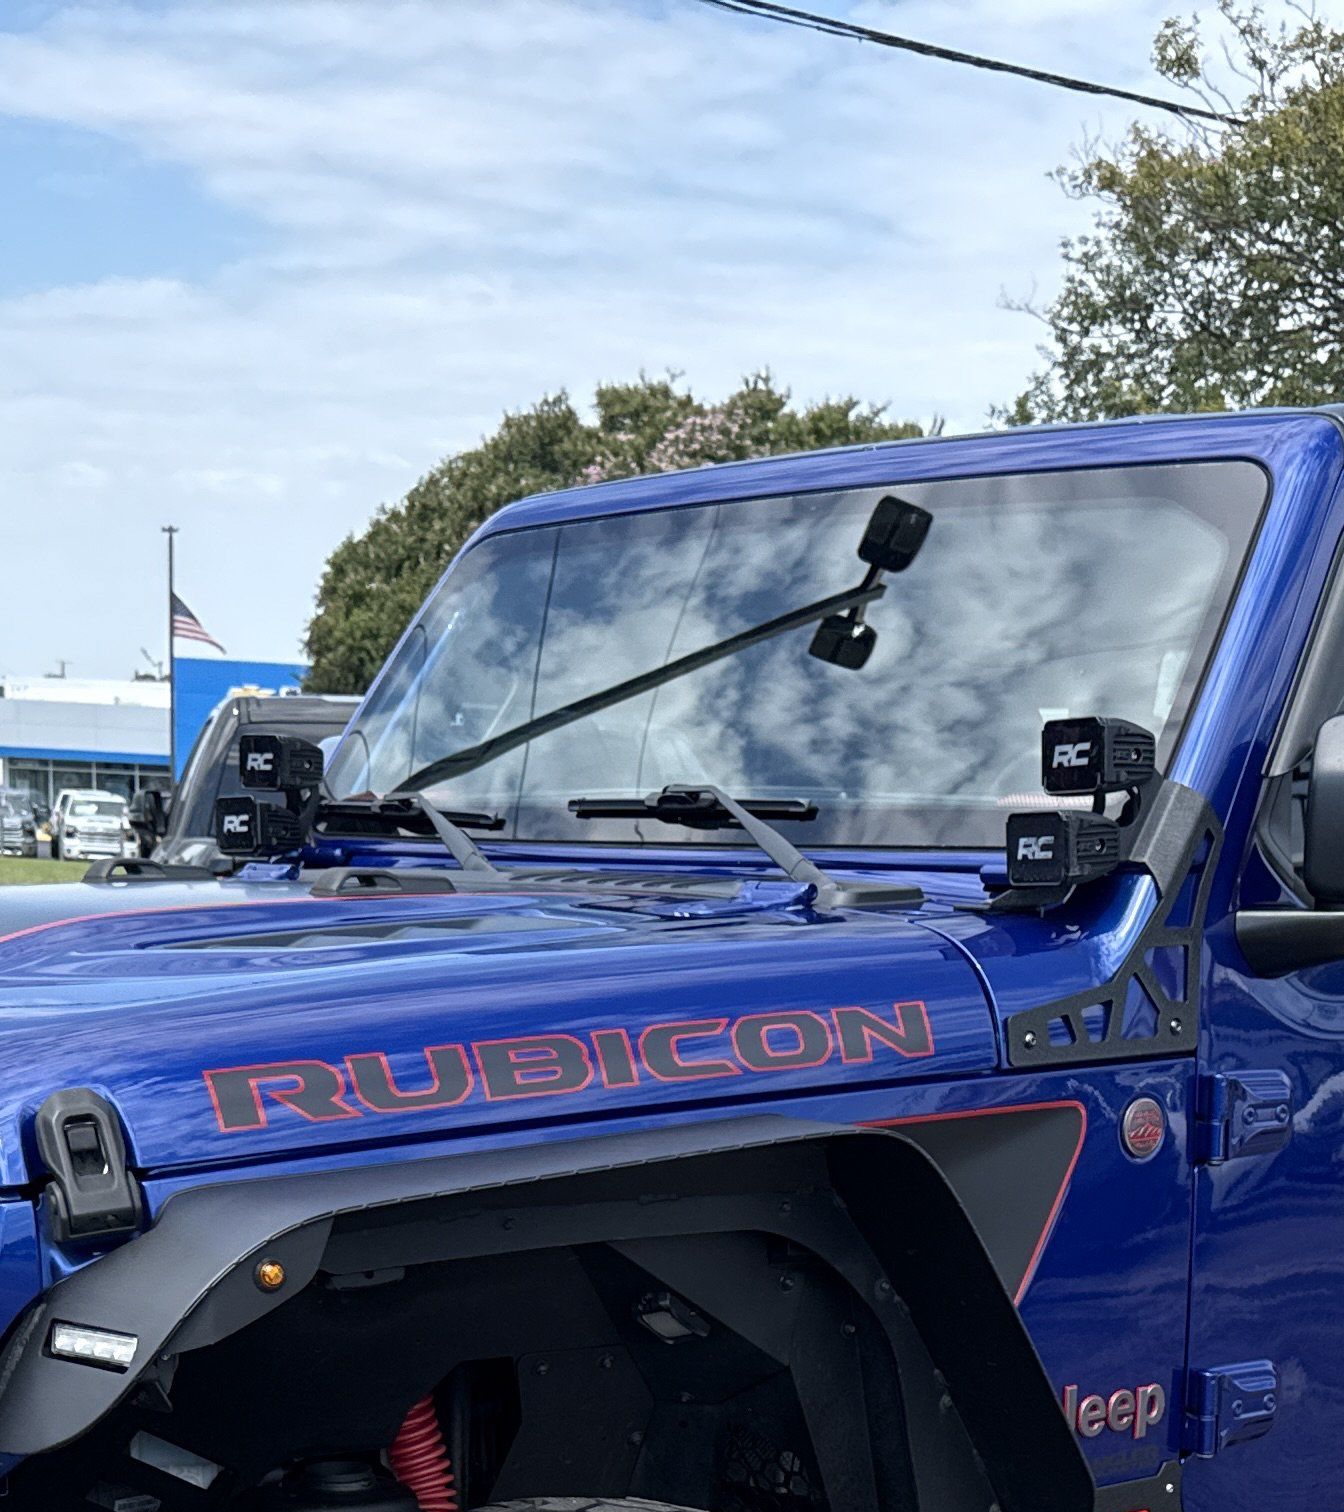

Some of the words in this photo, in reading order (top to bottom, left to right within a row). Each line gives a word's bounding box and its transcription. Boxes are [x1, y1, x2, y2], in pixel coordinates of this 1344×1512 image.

[246, 752, 274, 772] RC
[1052, 742, 1091, 769] RC
[223, 814, 249, 833] RC
[1017, 836, 1055, 861] RC
[203, 1000, 935, 1133] RUBICON
